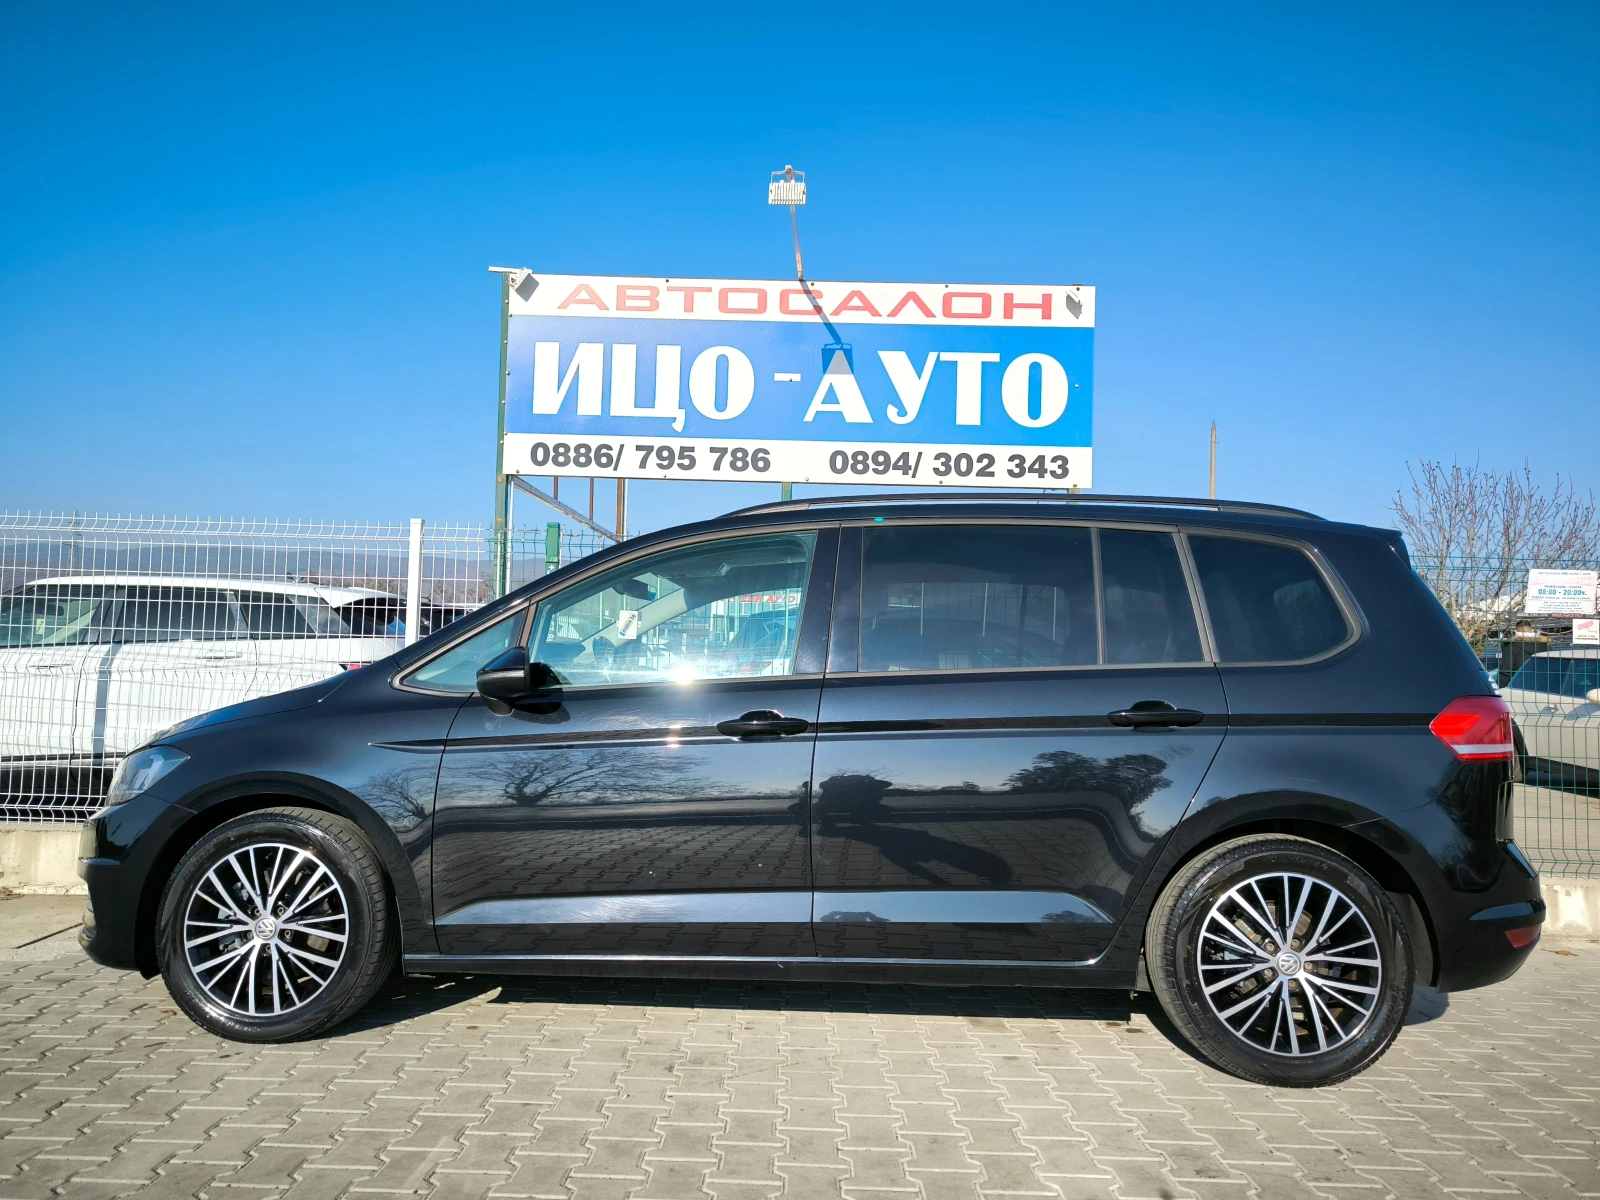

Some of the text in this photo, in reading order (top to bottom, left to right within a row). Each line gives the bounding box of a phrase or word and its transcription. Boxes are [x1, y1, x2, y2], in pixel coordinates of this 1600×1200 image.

[557, 283, 1052, 320] АВТОСАЛОН
[533, 341, 754, 432] ИЦО
[803, 350, 1069, 428] АУТО
[530, 442, 771, 473] 0886/ 795 786
[829, 450, 1069, 479] 0894/ 302 343
[1538, 588, 1557, 596] 08:00
